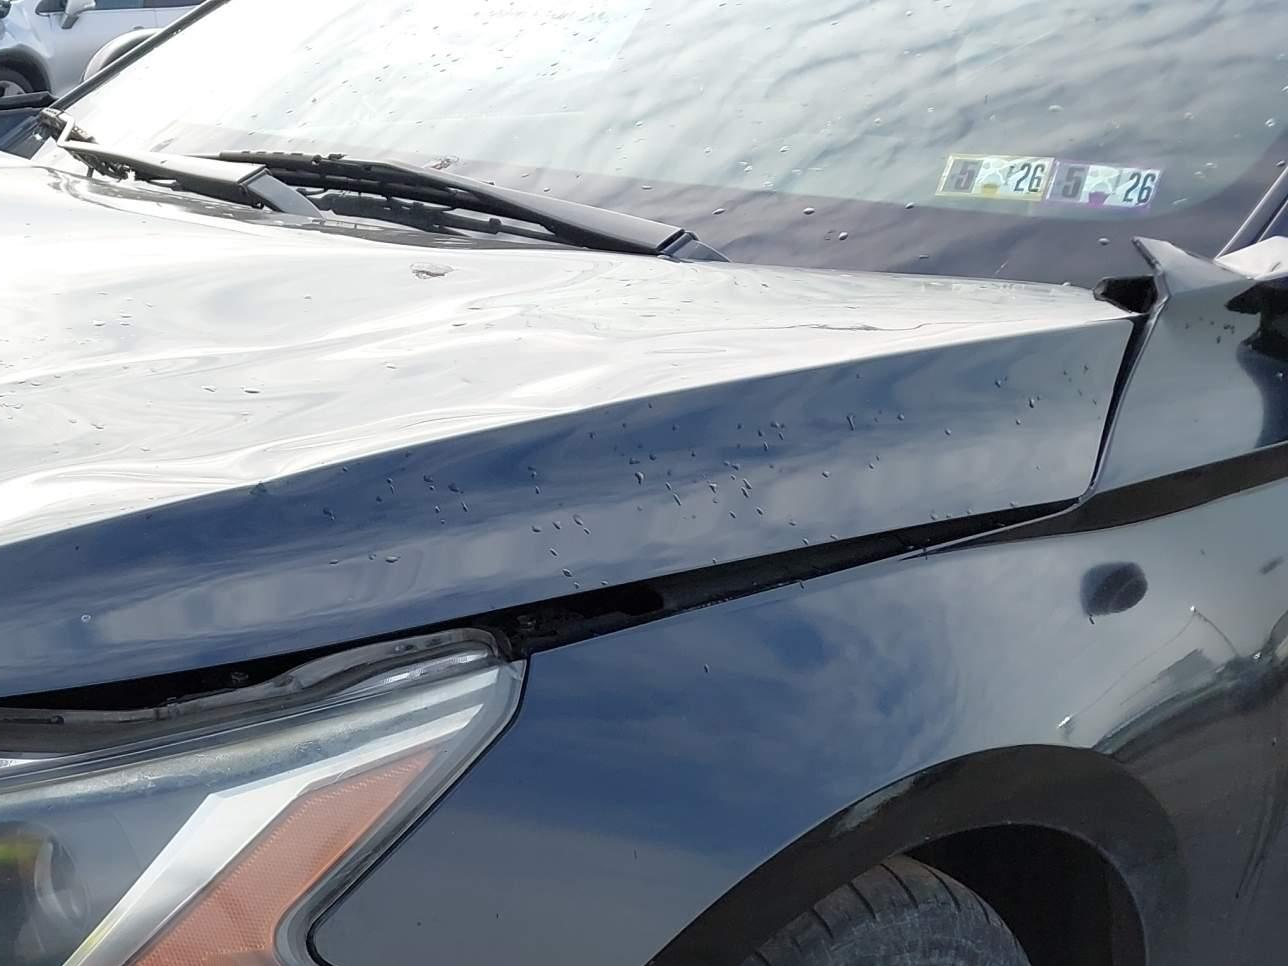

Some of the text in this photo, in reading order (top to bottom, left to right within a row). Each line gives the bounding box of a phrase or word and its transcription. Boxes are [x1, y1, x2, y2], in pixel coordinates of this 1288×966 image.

[954, 160, 978, 191] 5
[1014, 162, 1045, 193] 26
[1062, 167, 1157, 204] 5 26
